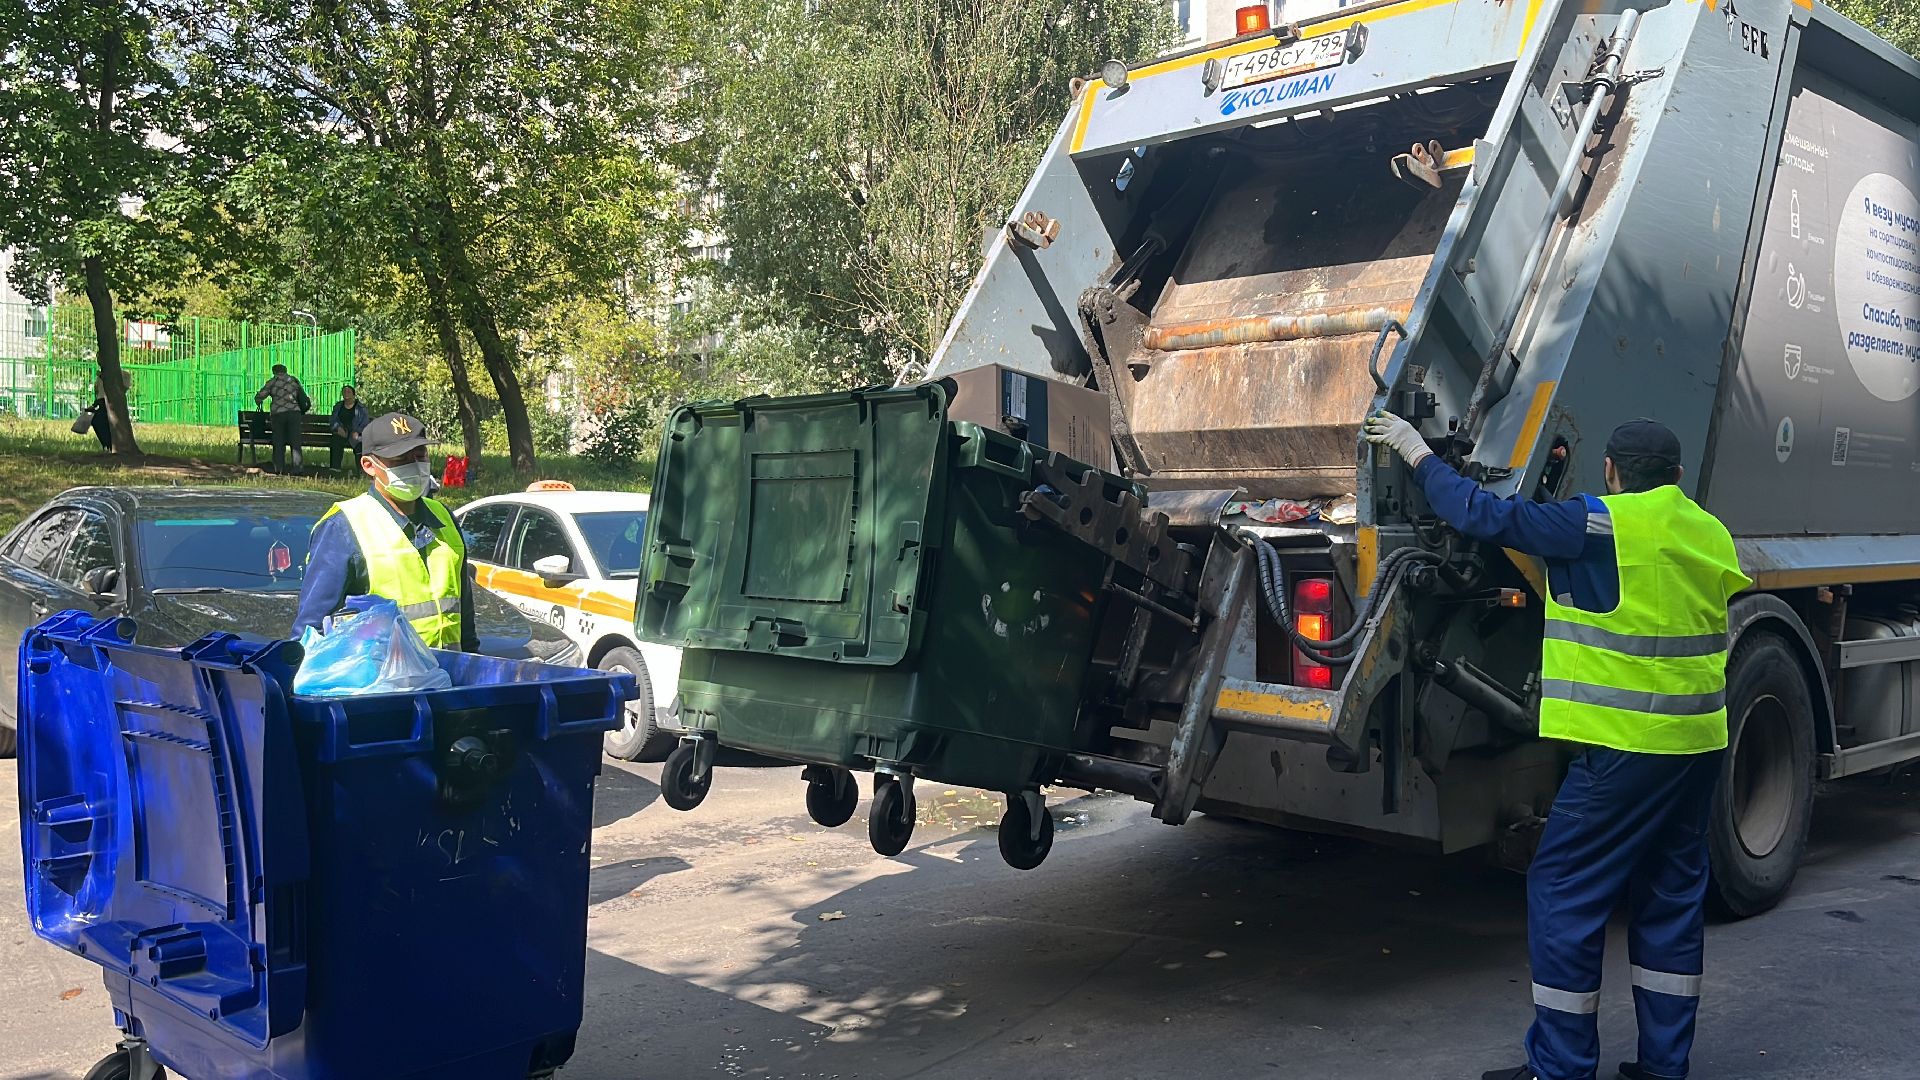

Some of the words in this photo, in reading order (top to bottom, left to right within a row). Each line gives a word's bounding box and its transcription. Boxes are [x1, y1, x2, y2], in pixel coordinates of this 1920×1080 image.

[1310, 35, 1341, 55] 799
[1238, 73, 1336, 110] KOLUMAN
[1864, 197, 1871, 214] Я
[1873, 203, 1892, 226] везу
[1869, 227, 1878, 238] на
[1866, 270, 1870, 280] и
[1863, 303, 1902, 331] Спасибо,
[1848, 331, 1904, 356] разделяете
[391, 417, 412, 434] NY
